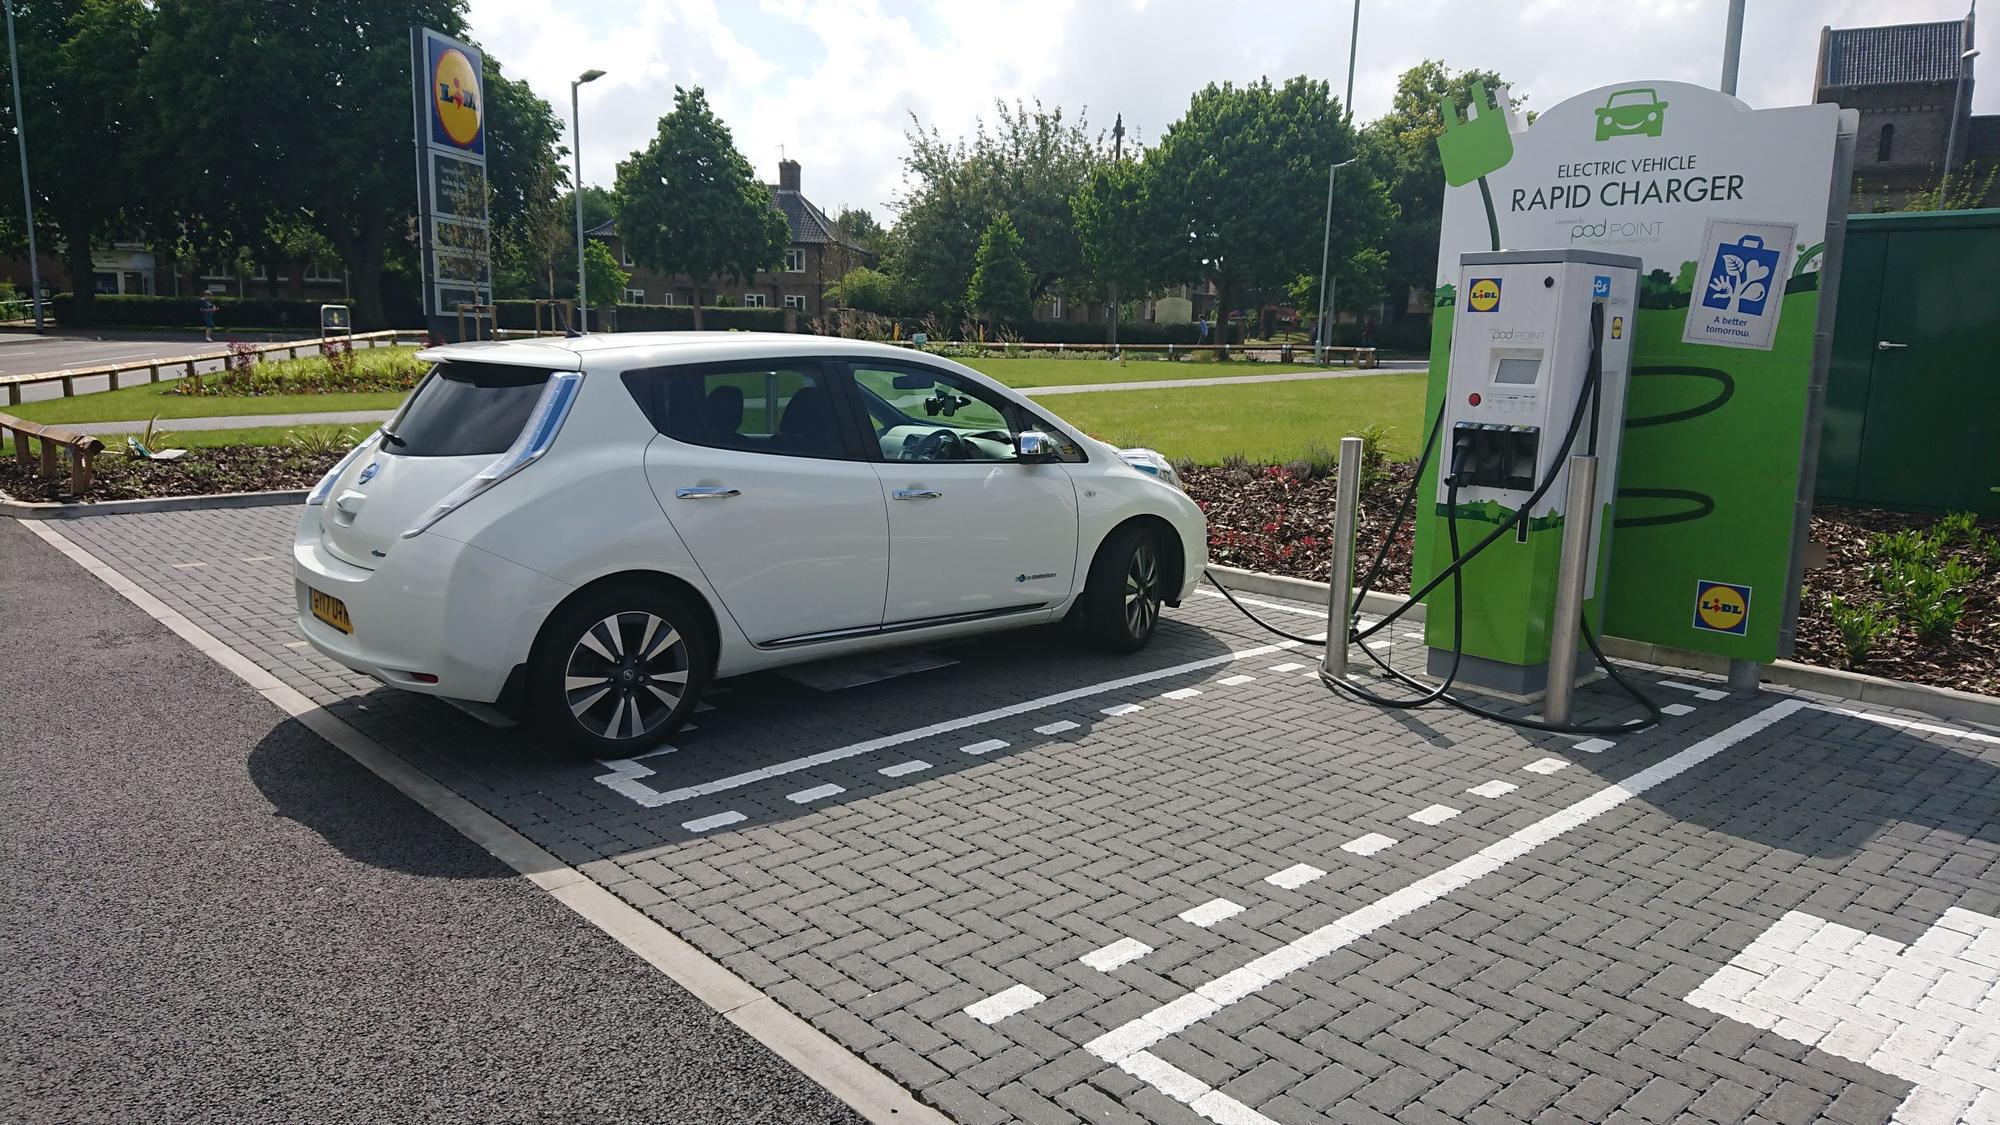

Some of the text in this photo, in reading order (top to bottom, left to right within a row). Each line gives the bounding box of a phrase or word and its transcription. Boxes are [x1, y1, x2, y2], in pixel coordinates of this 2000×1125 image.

[1557, 155, 1697, 178] ELECTRIC VEHICLE
[1511, 174, 1744, 212] RAPID CHARGER
[1571, 217, 1665, 244] pod POINT
[1706, 324, 1751, 338] tomorrow.
[1713, 316, 1748, 327] A better
